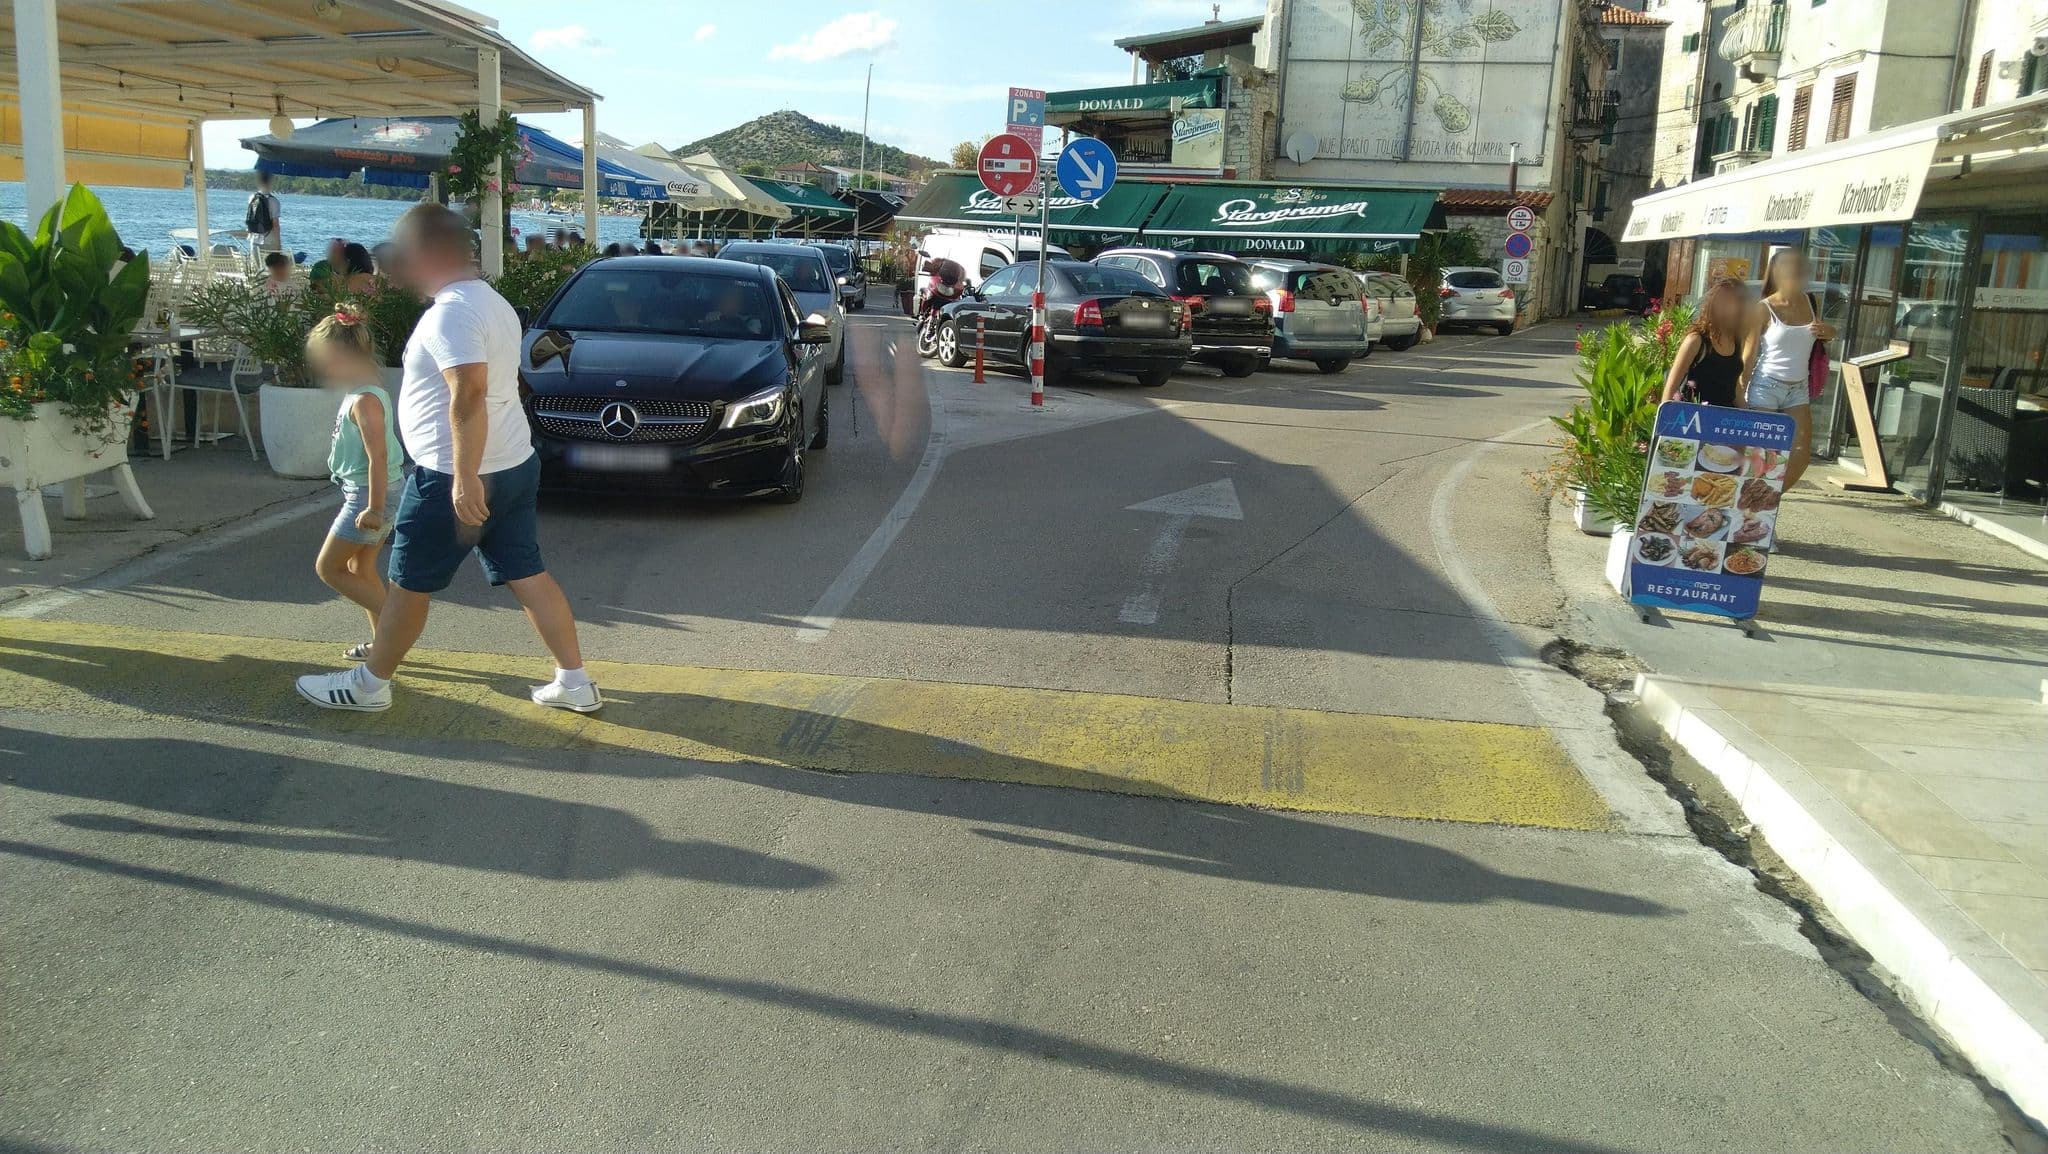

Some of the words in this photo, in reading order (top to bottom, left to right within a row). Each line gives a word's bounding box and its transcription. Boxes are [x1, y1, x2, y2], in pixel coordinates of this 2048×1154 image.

[1014, 90, 1034, 99] ZONA
[1012, 99, 1028, 122] P
[1079, 98, 1144, 111] DOMALD
[1838, 177, 1893, 216] Karlovačko
[1211, 198, 1368, 226] Staropramen
[1245, 239, 1305, 251] DOMALD
[1510, 264, 1521, 273] 20
[1714, 427, 1788, 441] RESTAURANT
[1647, 584, 1737, 603] RESTAURANT
